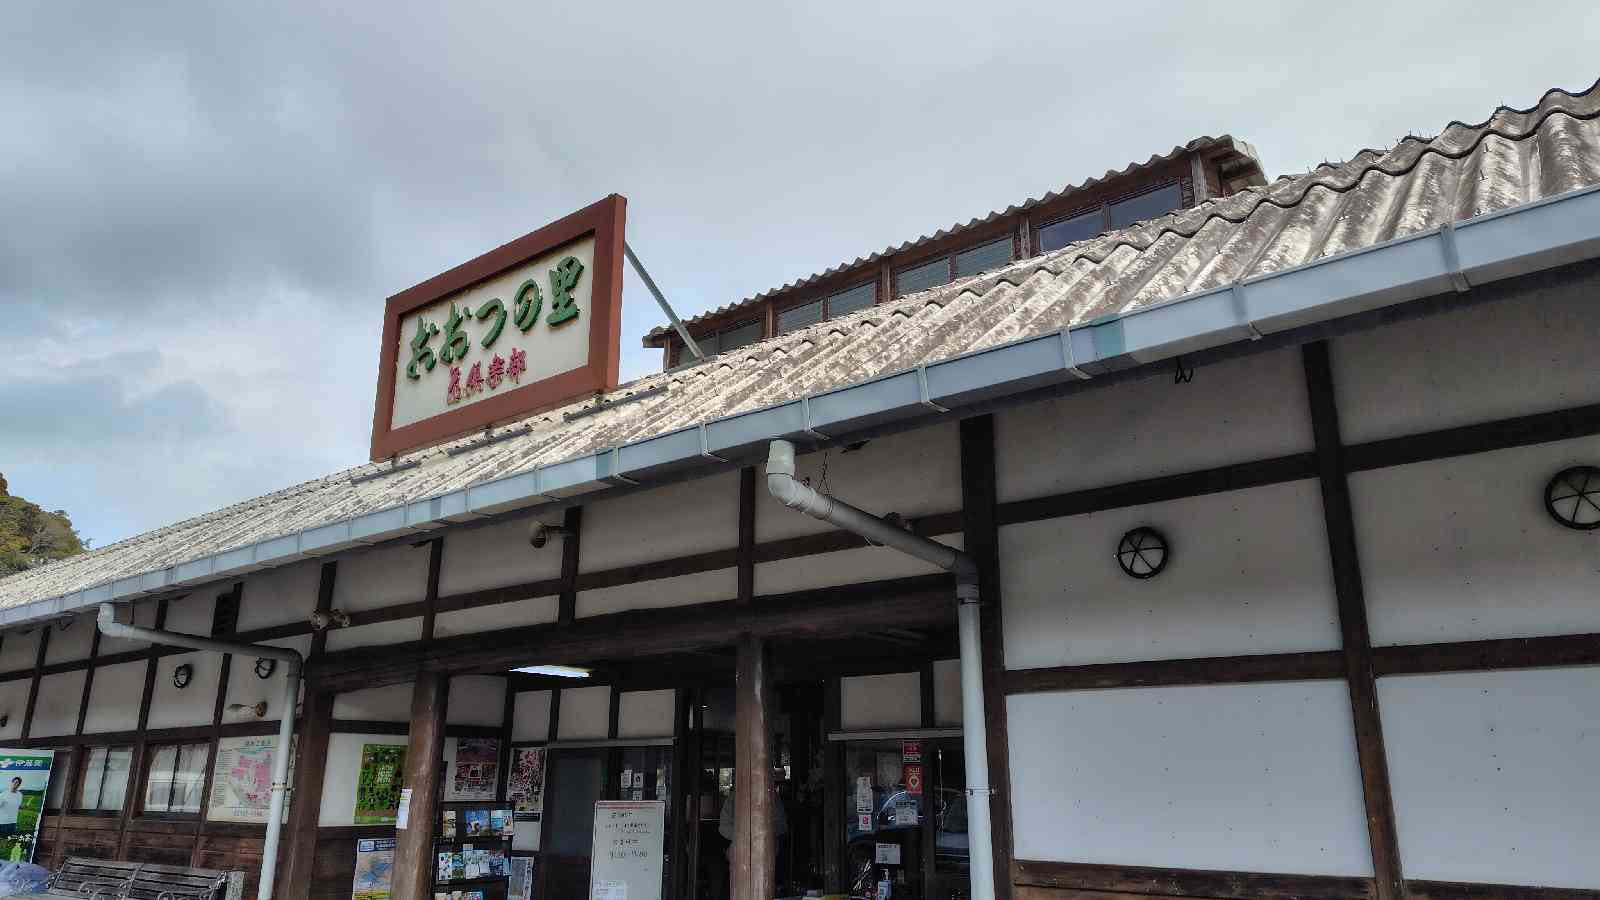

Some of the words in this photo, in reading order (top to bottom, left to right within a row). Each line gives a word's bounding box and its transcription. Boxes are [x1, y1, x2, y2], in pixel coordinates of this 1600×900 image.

[406, 255, 584, 380] おおつの里
